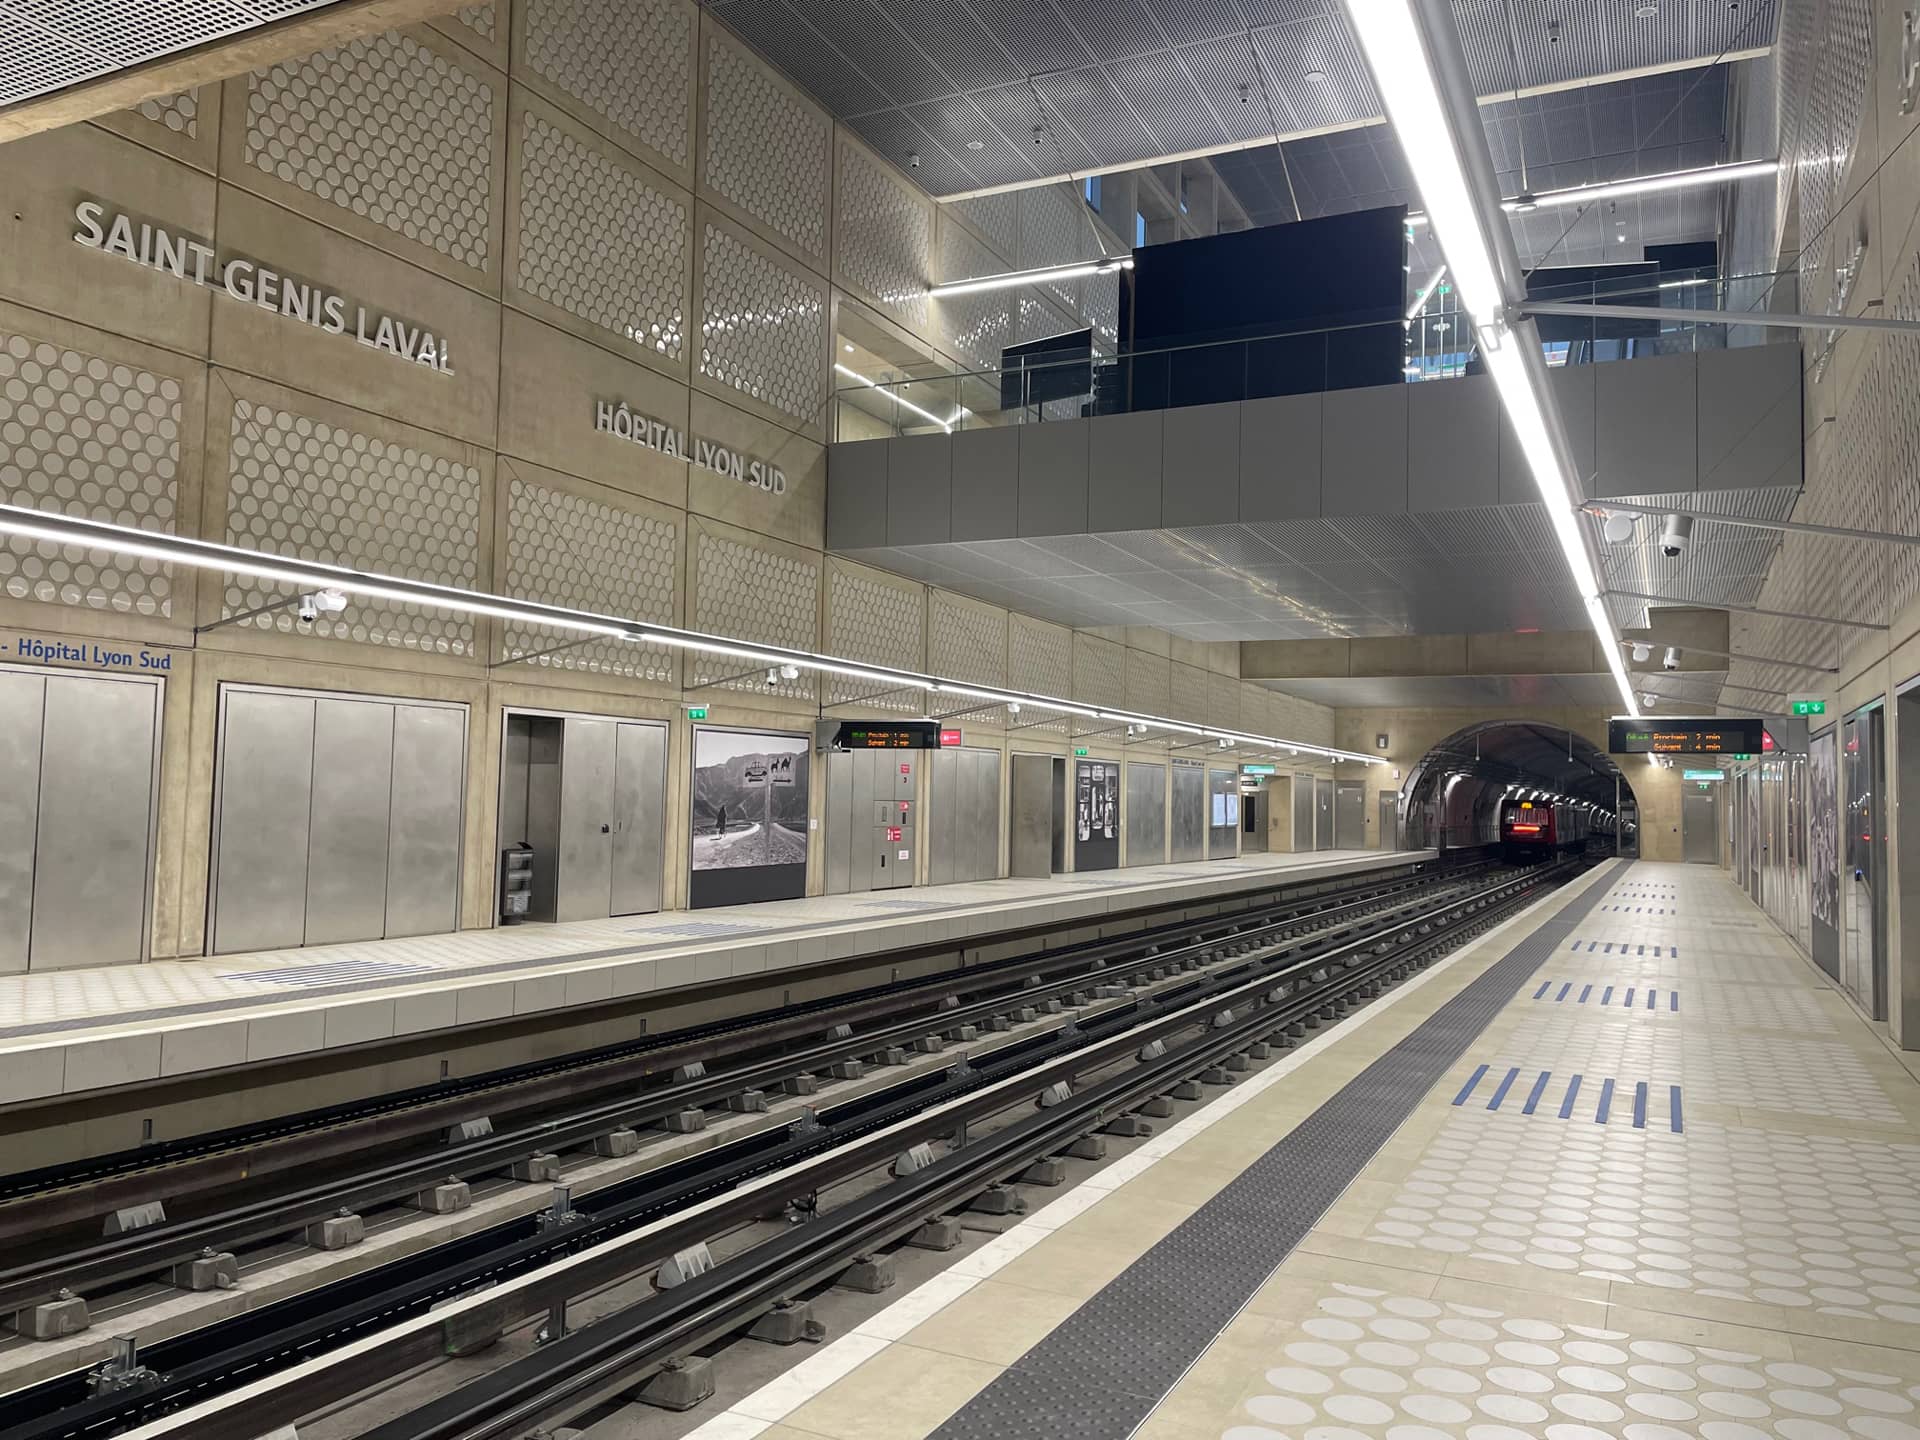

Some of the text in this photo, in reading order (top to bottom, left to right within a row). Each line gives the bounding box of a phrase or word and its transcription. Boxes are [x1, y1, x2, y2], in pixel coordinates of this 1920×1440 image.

[73, 201, 455, 376] SAINT GENIS LAVAL
[596, 401, 787, 496] HÔPITAL LYON SUD
[18, 637, 87, 663] Hôpital
[93, 645, 133, 667] Lyon
[139, 650, 171, 670] Sud
[1705, 743, 1721, 751] min
